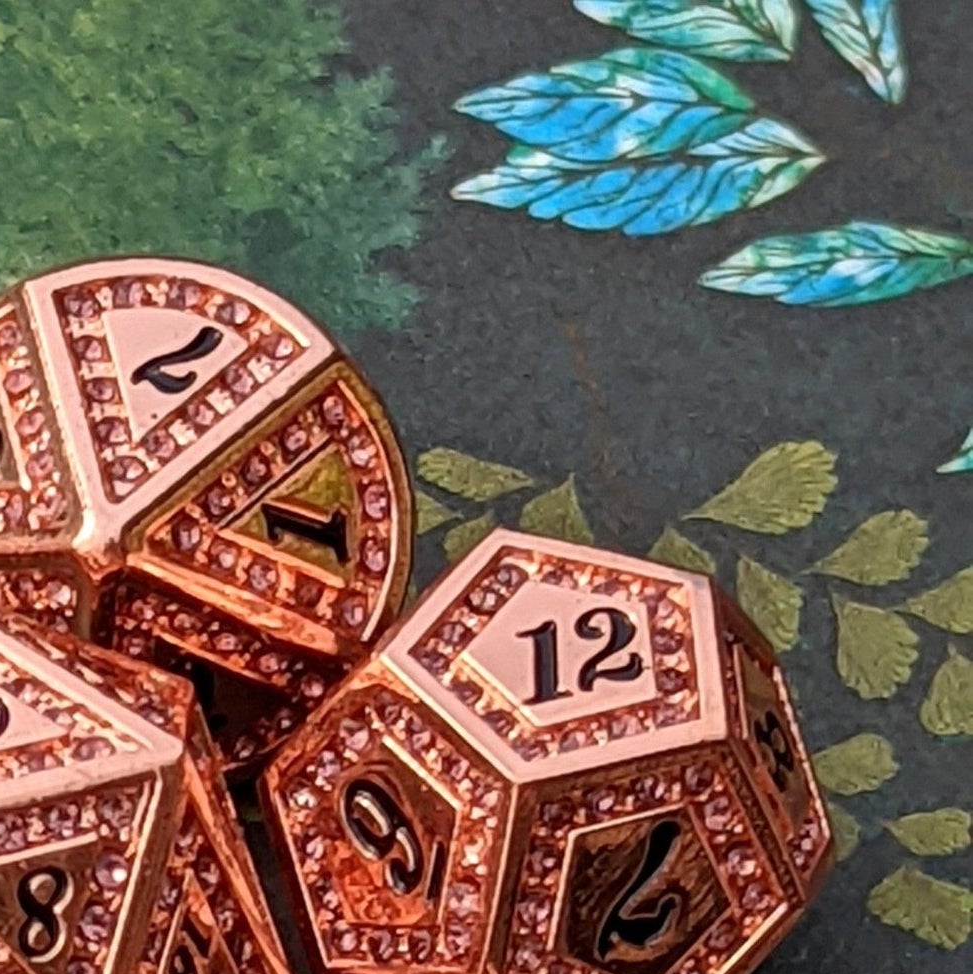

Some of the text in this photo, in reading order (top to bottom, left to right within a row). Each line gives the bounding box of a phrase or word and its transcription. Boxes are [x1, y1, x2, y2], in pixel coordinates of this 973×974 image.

[130, 326, 224, 394] 7
[261, 502, 350, 563] 1
[515, 606, 645, 703] 12
[16, 865, 73, 964] 8
[595, 819, 682, 963] 7
